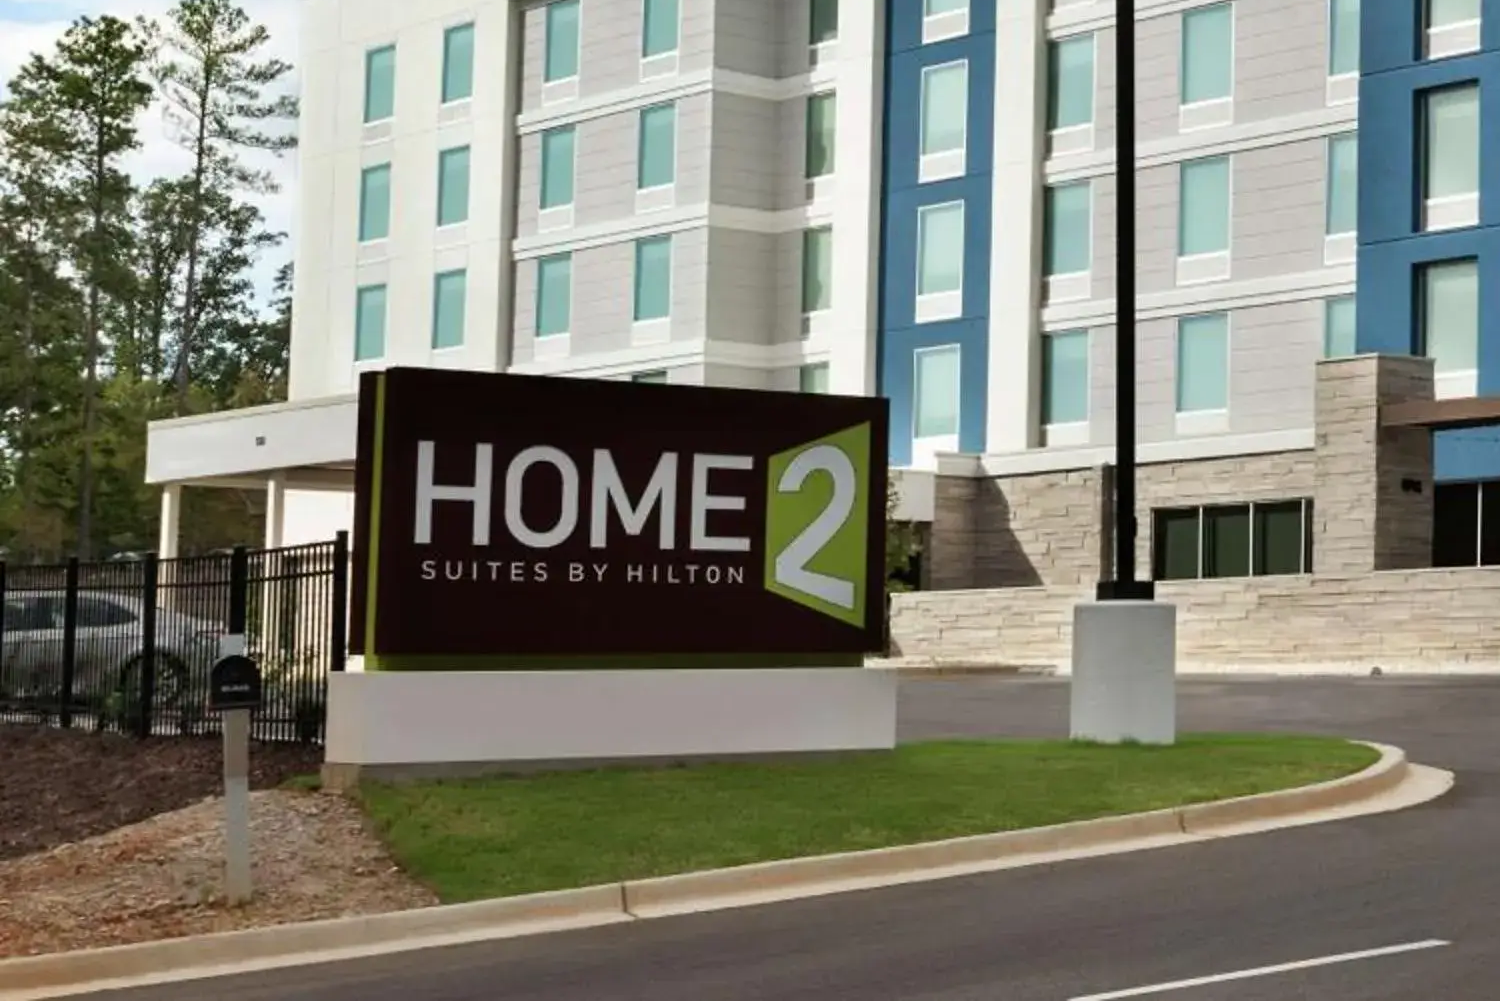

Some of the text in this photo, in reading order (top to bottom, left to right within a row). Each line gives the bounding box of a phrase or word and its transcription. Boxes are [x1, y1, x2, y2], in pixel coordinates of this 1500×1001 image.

[413, 440, 856, 610] HOME 2
[421, 560, 745, 585] SUITES BY HILTON
